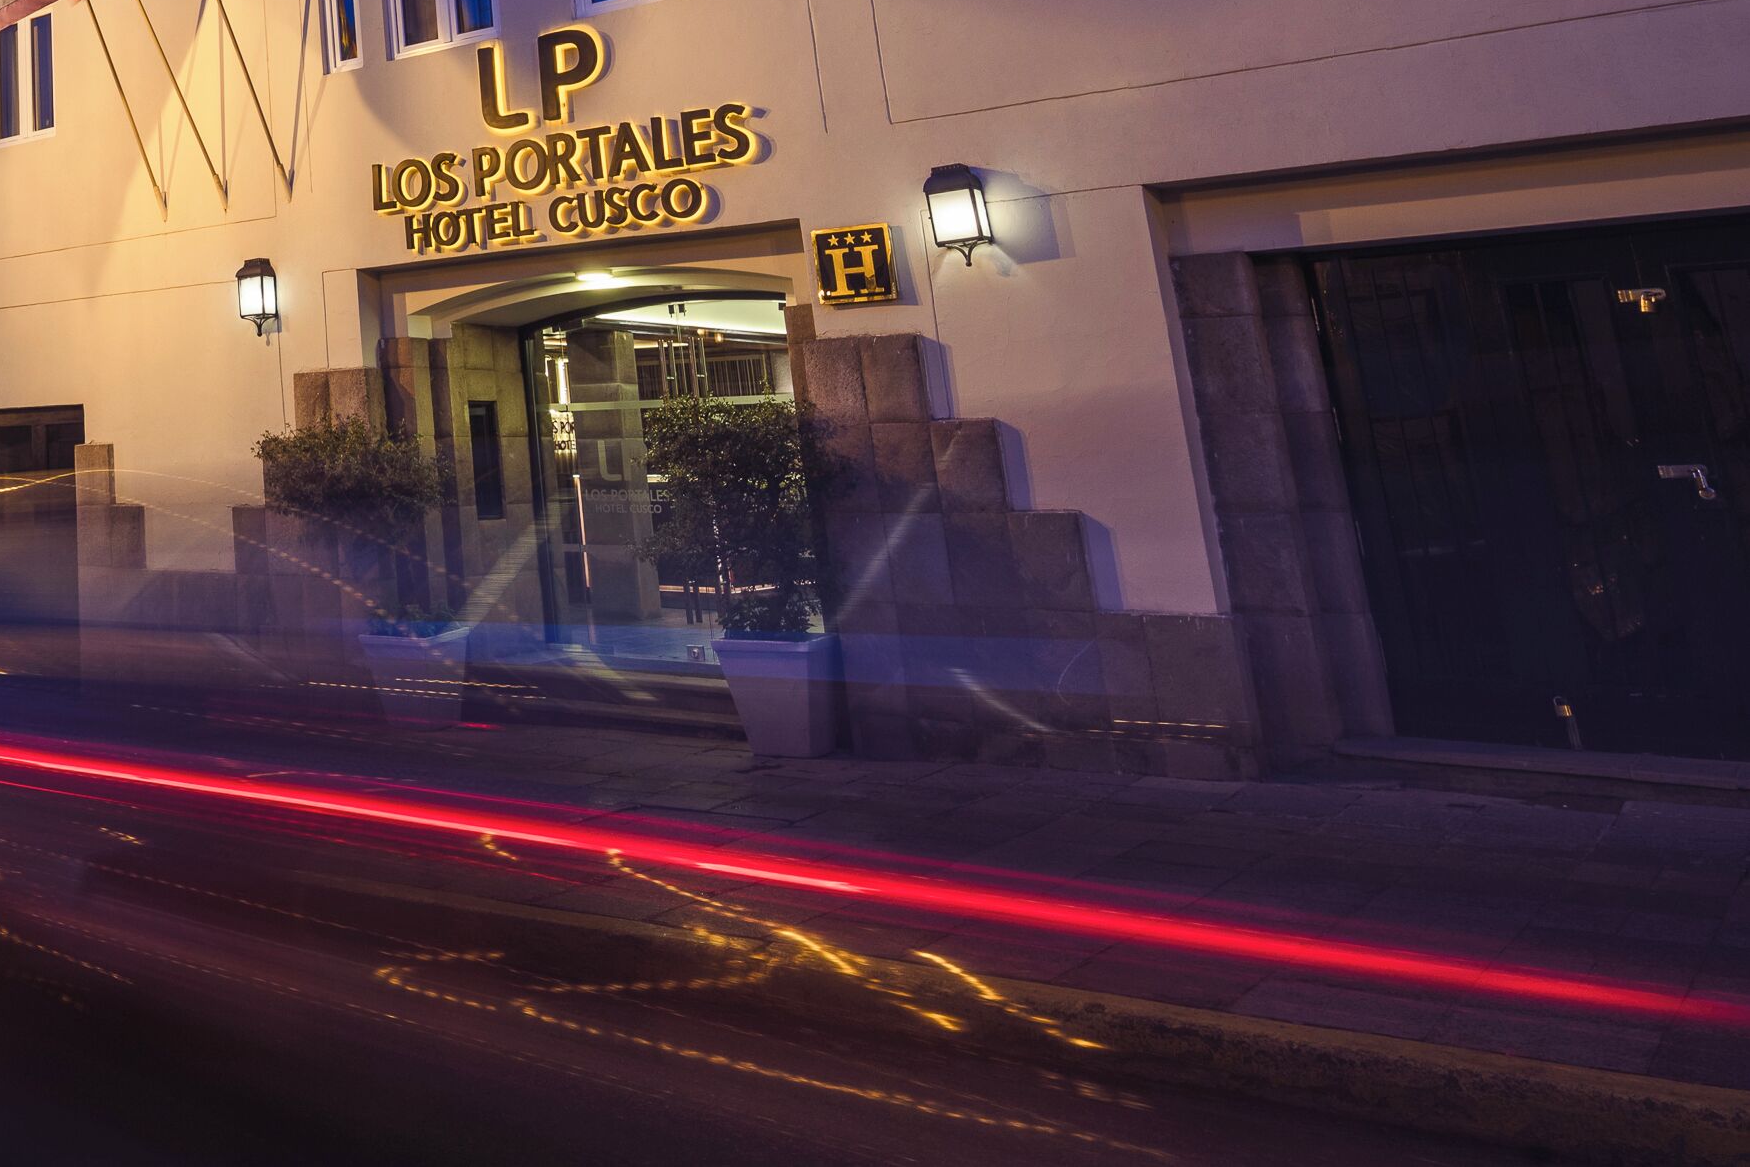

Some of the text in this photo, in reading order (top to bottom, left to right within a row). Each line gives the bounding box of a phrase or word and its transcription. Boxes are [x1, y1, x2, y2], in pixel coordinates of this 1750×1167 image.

[372, 103, 752, 212] LOS PORTALES
[404, 177, 704, 251] HOTEL CUSCO
[824, 244, 885, 297] H
[585, 487, 671, 503] LOS PORTALES
[595, 503, 663, 514] HOTEL CUSCO
